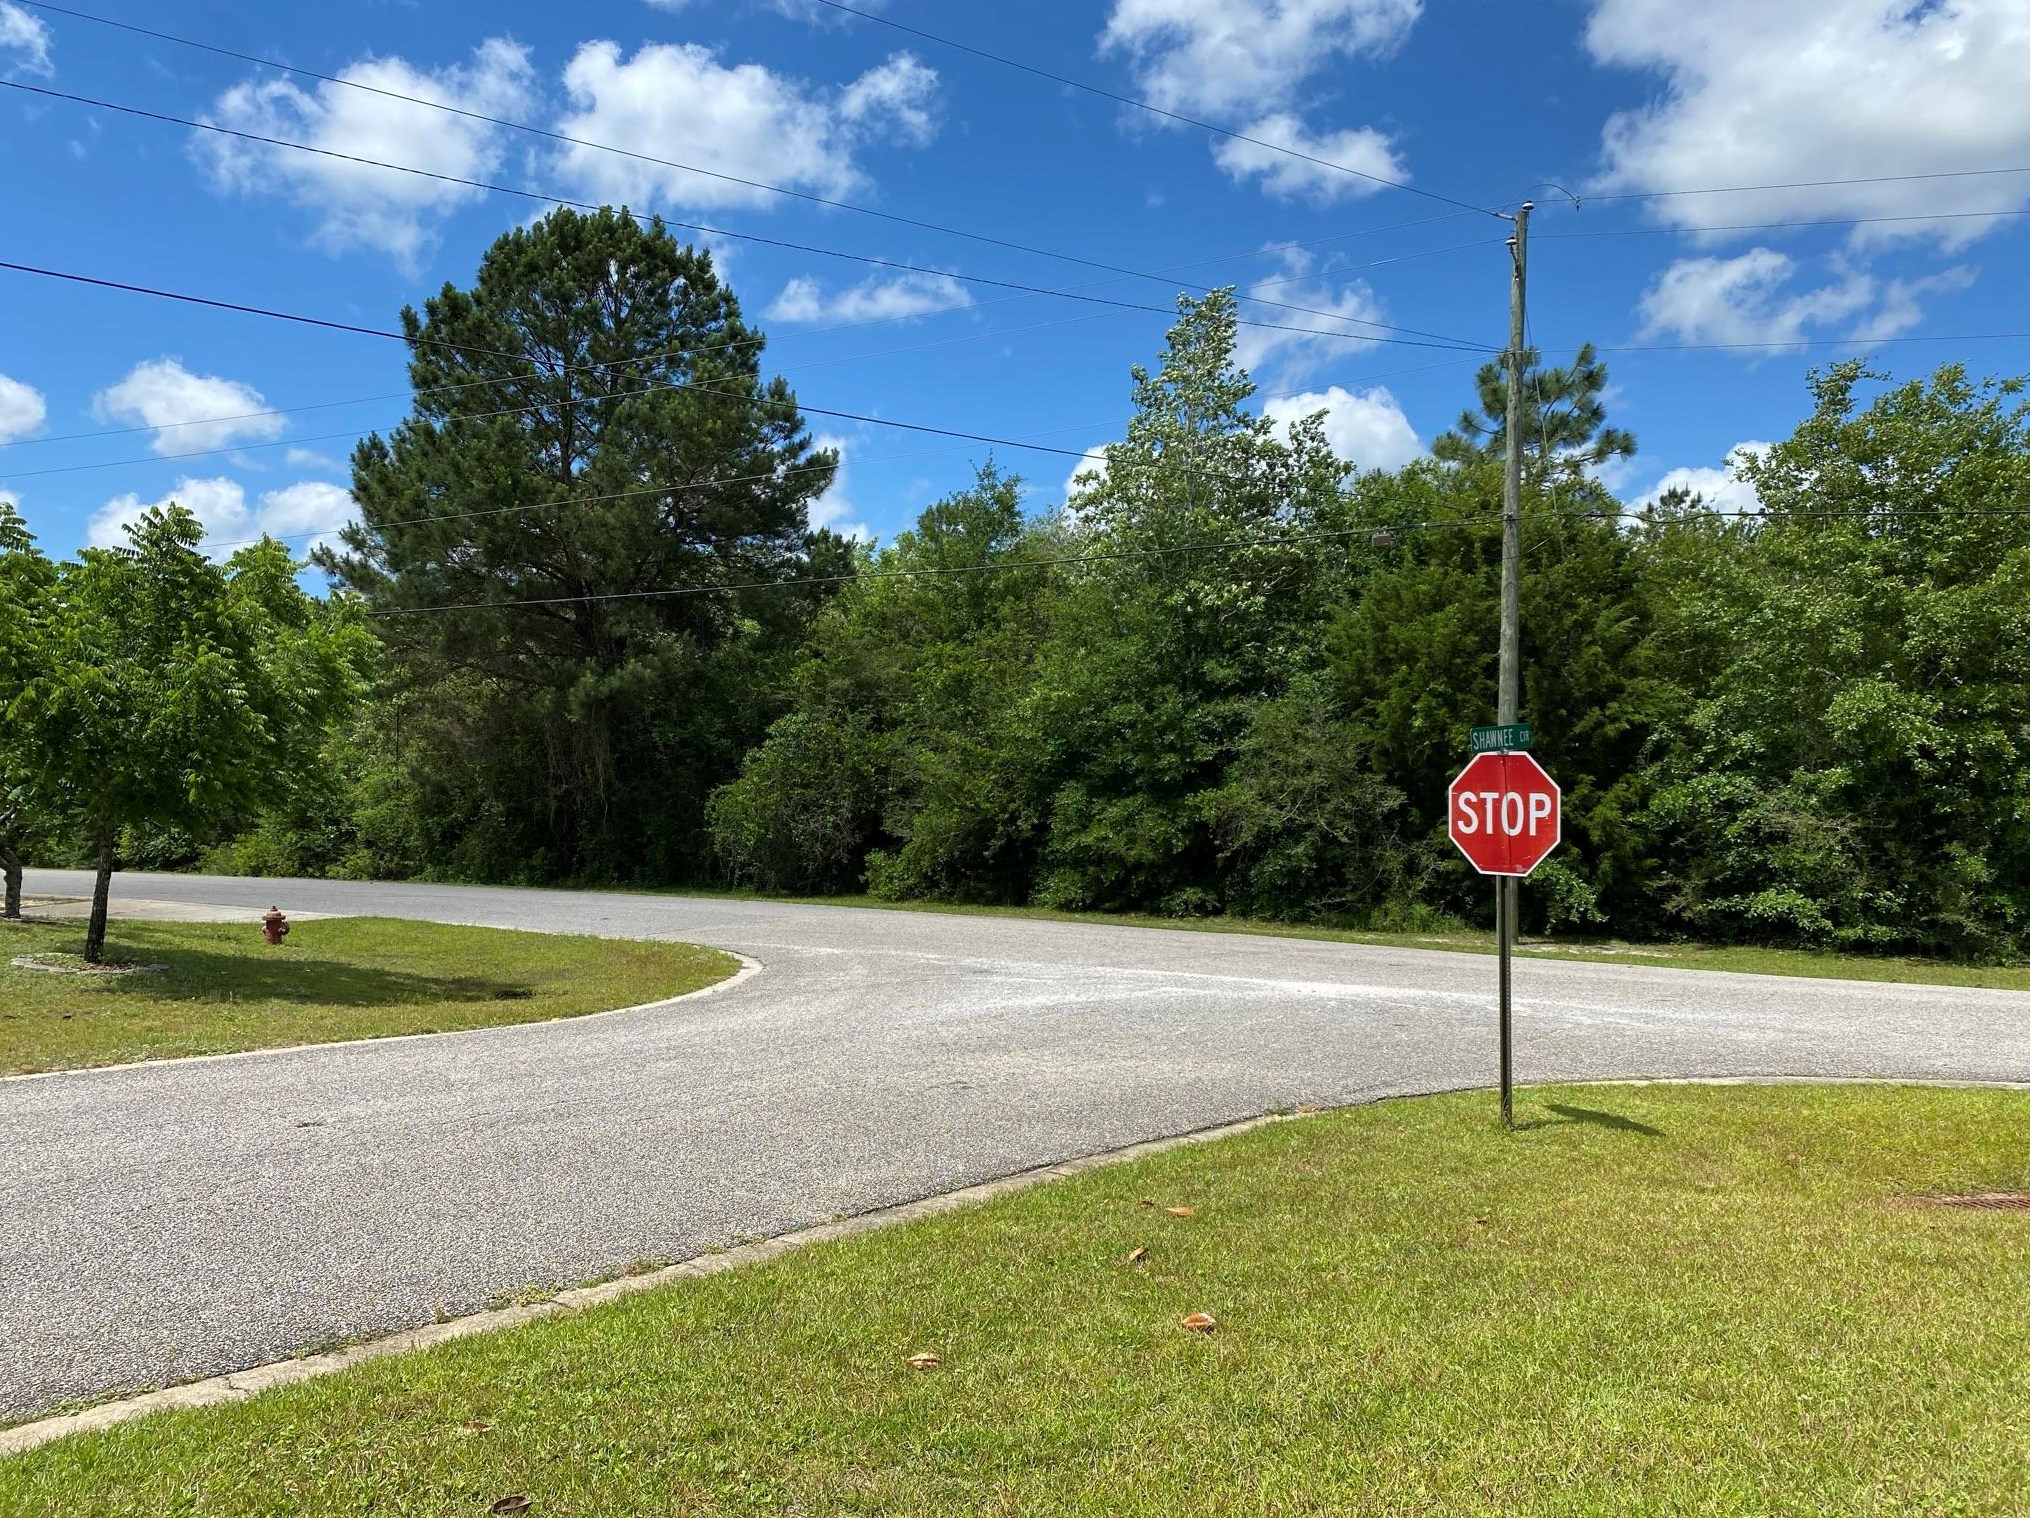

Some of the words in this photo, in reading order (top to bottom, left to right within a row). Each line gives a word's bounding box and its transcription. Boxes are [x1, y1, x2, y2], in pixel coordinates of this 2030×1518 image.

[1473, 728, 1514, 750] SHAWNEE
[1519, 730, 1530, 742] CIR
[1457, 791, 1552, 837] STOP
